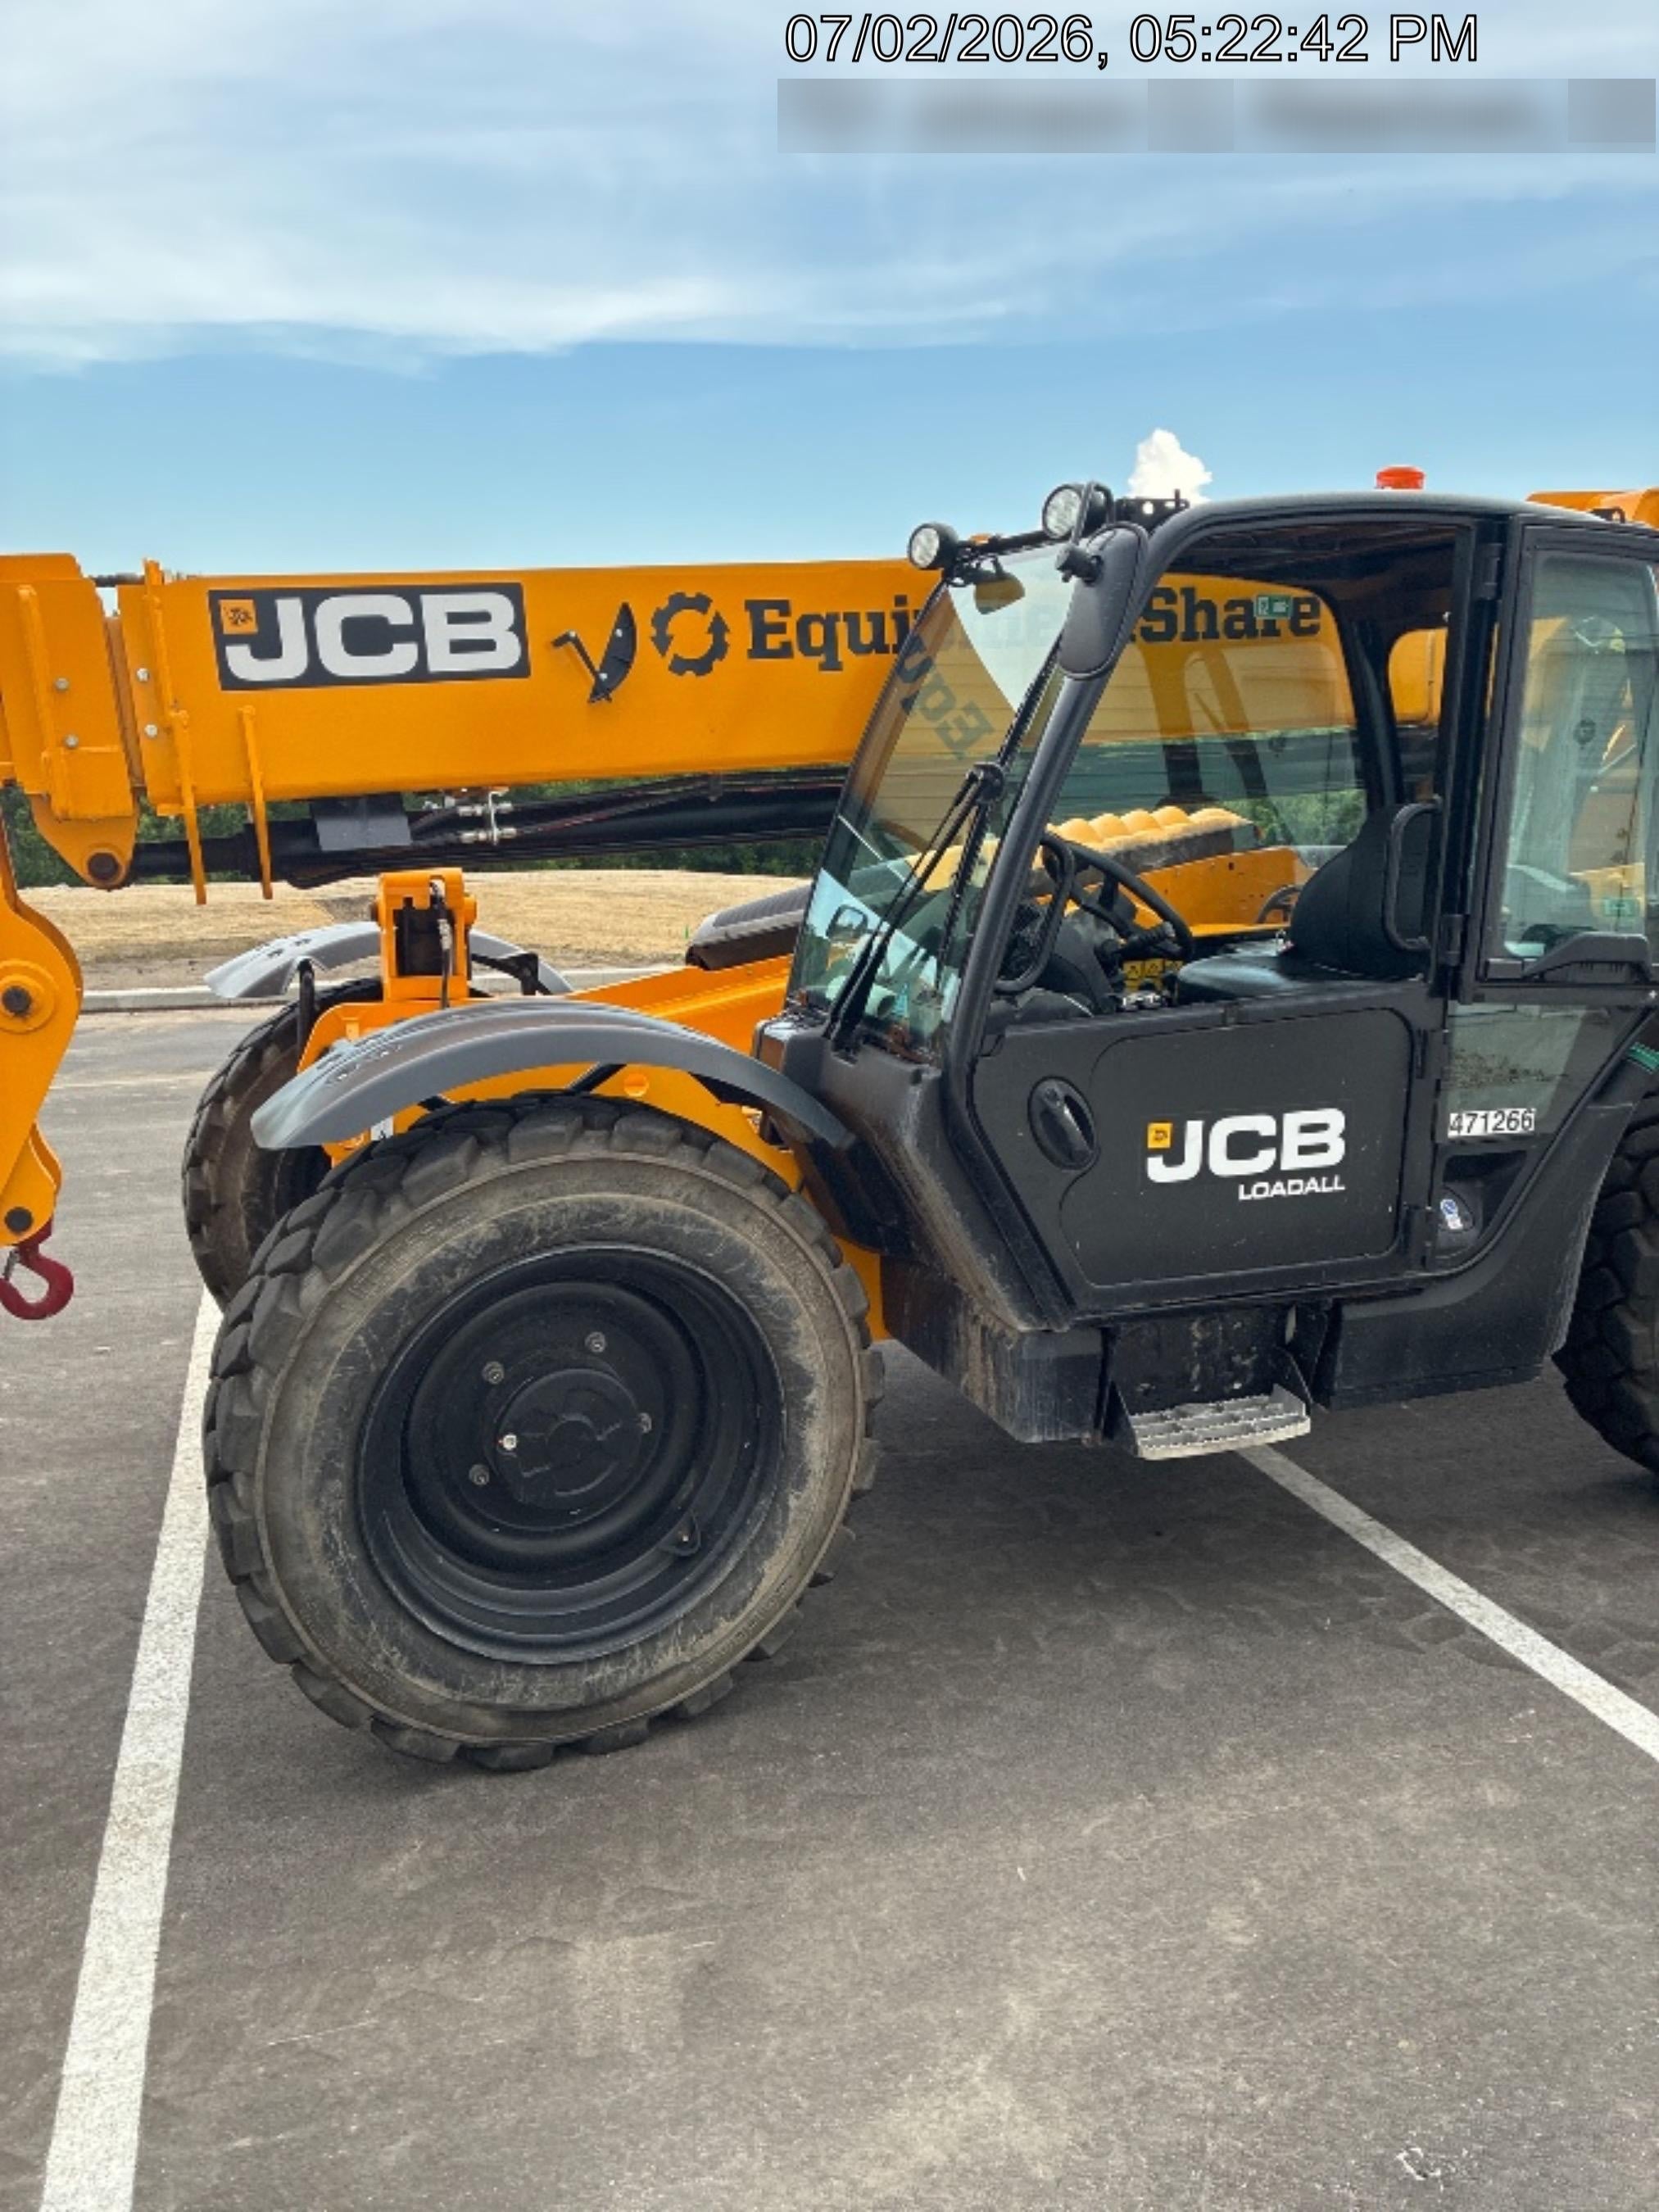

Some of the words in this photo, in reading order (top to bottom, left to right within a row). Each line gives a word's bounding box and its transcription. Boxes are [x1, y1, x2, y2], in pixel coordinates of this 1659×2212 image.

[225, 592, 522, 682] JCB
[1146, 1108, 1346, 1183] JCB
[1449, 1109, 1535, 1135] 471266
[1238, 1175, 1346, 1202] LOADALL
